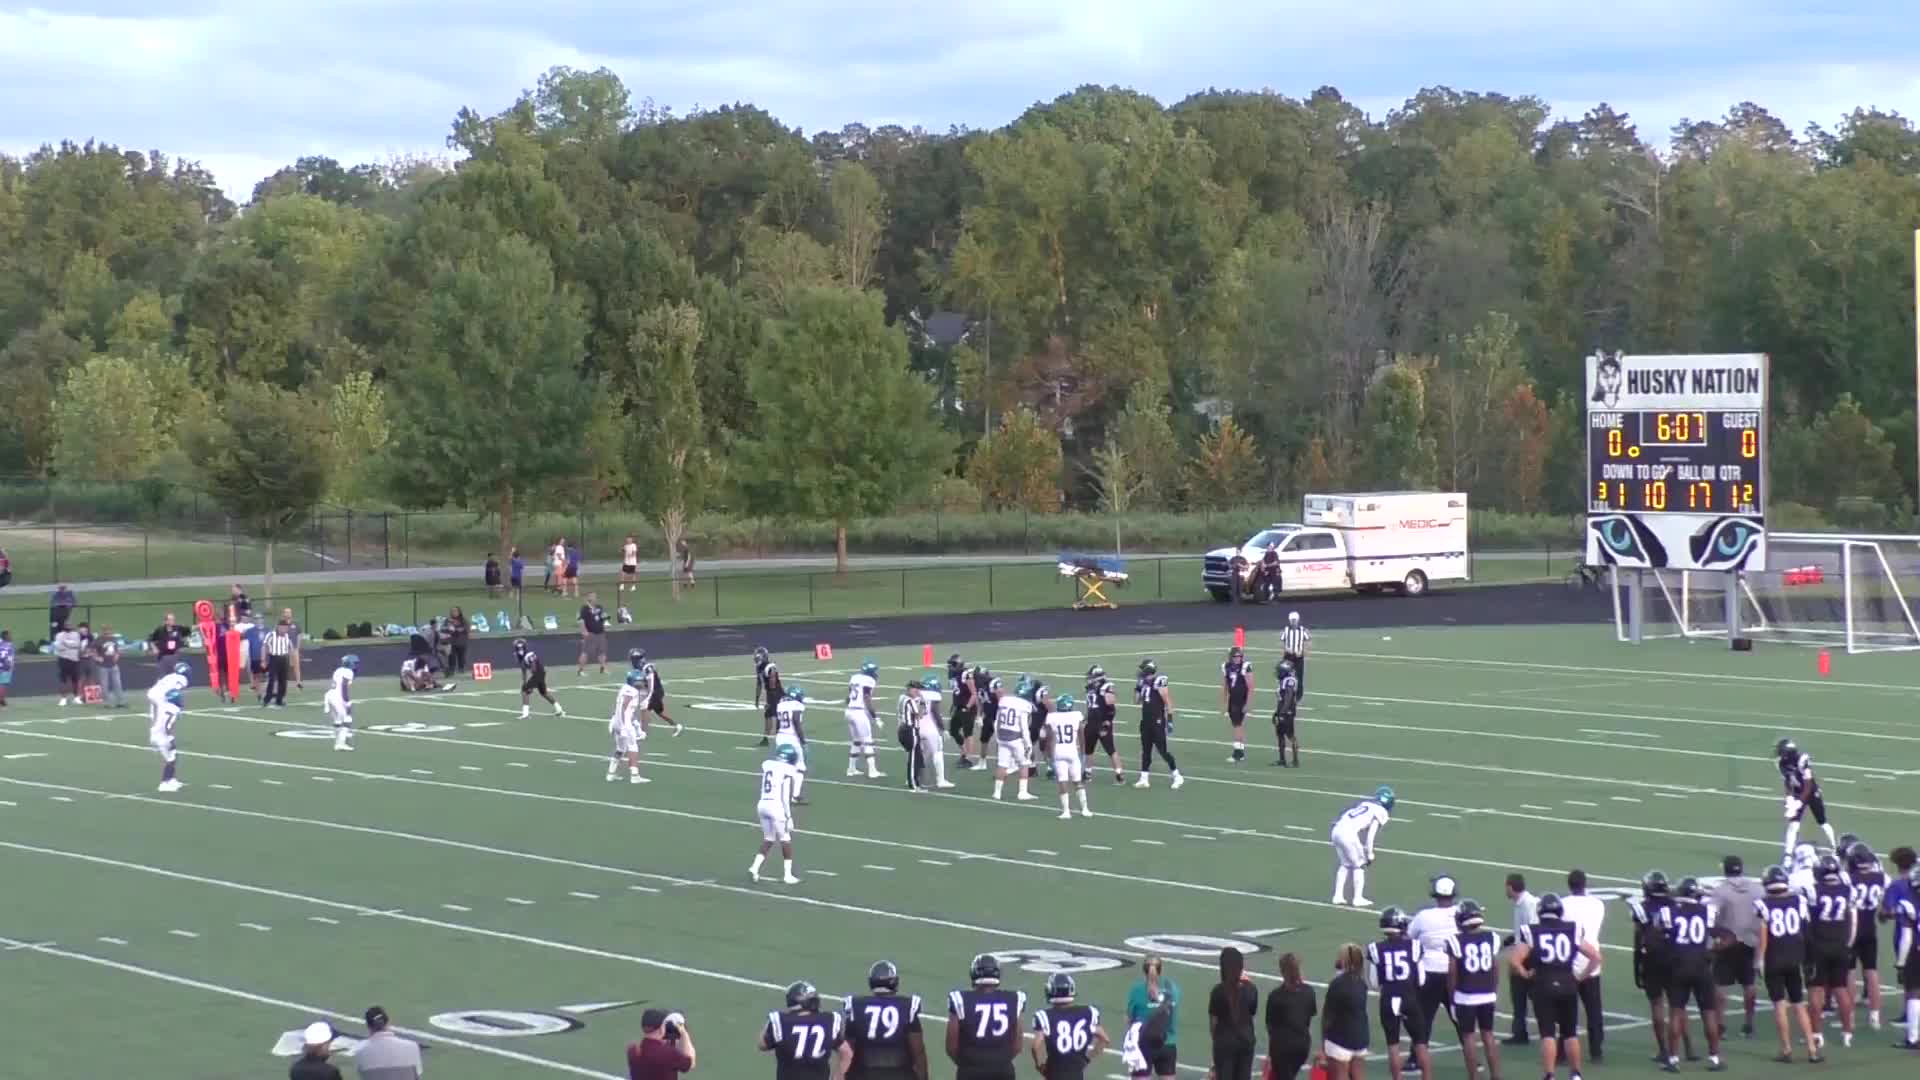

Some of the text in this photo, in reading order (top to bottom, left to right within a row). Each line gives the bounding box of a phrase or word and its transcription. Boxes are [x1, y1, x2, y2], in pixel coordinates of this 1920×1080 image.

[1627, 368, 1759, 394] HUSKY NATION
[1592, 413, 1624, 428] HOME
[1657, 413, 1704, 441] 6:07
[1722, 413, 1758, 428] GUEST
[1609, 429, 1621, 456] 0
[1742, 430, 1756, 458] 0
[1603, 464, 1633, 479] DOWN
[1636, 464, 1666, 480] TO GO
[1677, 465, 1716, 480] BALL ON
[1719, 465, 1742, 480] QTR
[1598, 482, 1607, 500] 3
[1619, 482, 1625, 507] 1
[1645, 481, 1666, 509] 10
[1689, 482, 1712, 508] 17
[1399, 519, 1438, 528] MEDIC
[1229, 672, 1238, 688] 7
[1056, 724, 1074, 745] 19
[764, 770, 773, 794] 6
[1819, 895, 1847, 921] 22
[1674, 915, 1706, 945] 20
[1769, 906, 1801, 937] 80
[1464, 942, 1492, 973] 88
[1539, 933, 1572, 963] 50
[1384, 950, 1411, 982] 15
[864, 1005, 900, 1039] 79
[974, 1003, 1009, 1038] 75
[791, 1025, 827, 1059] 72
[1056, 1018, 1088, 1054] 86
